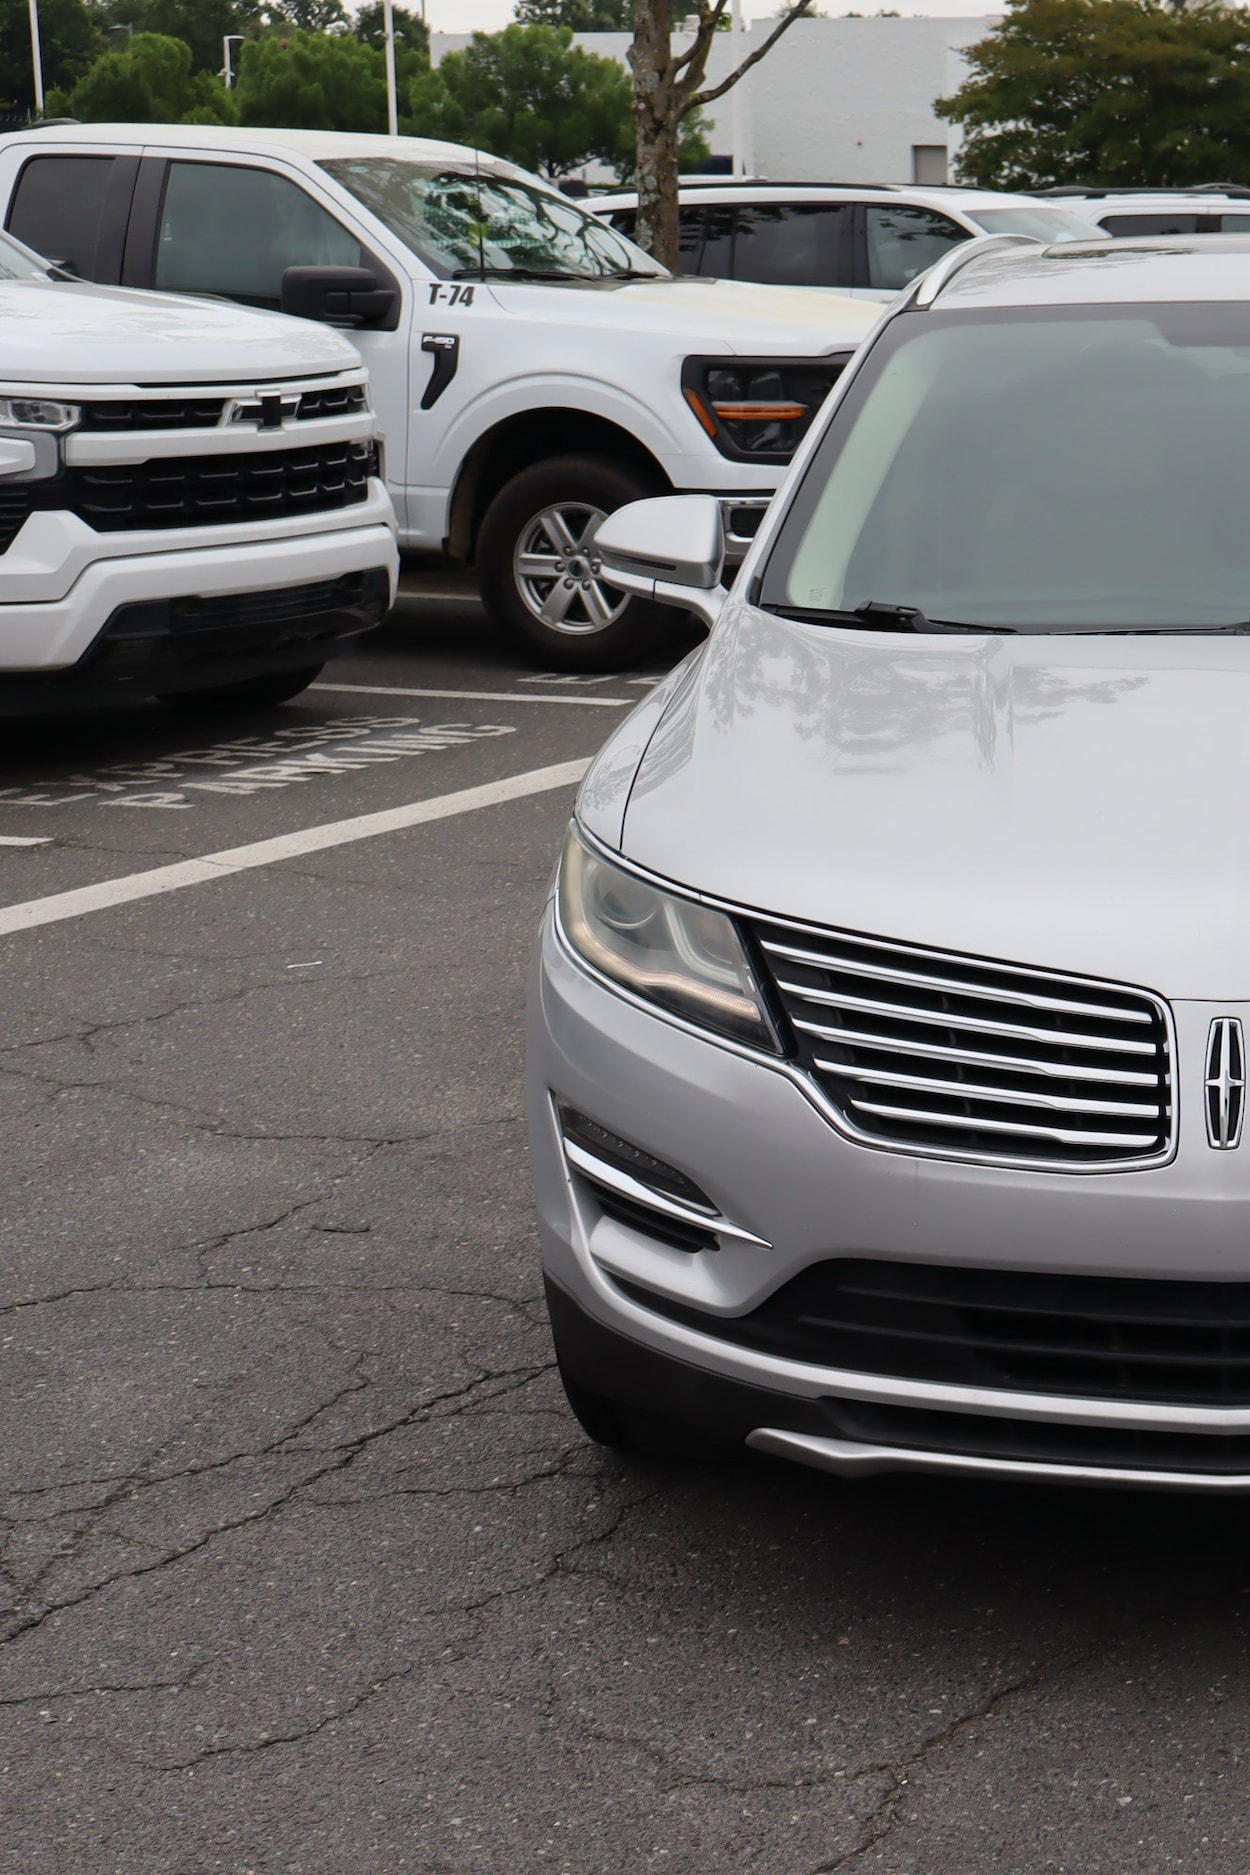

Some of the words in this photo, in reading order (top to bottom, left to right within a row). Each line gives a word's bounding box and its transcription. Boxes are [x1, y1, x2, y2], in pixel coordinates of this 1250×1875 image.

[429, 283, 475, 307] T-74
[423, 336, 455, 344] F-150
[0, 715, 420, 806] EXPRESS
[98, 722, 517, 809] PARKING
